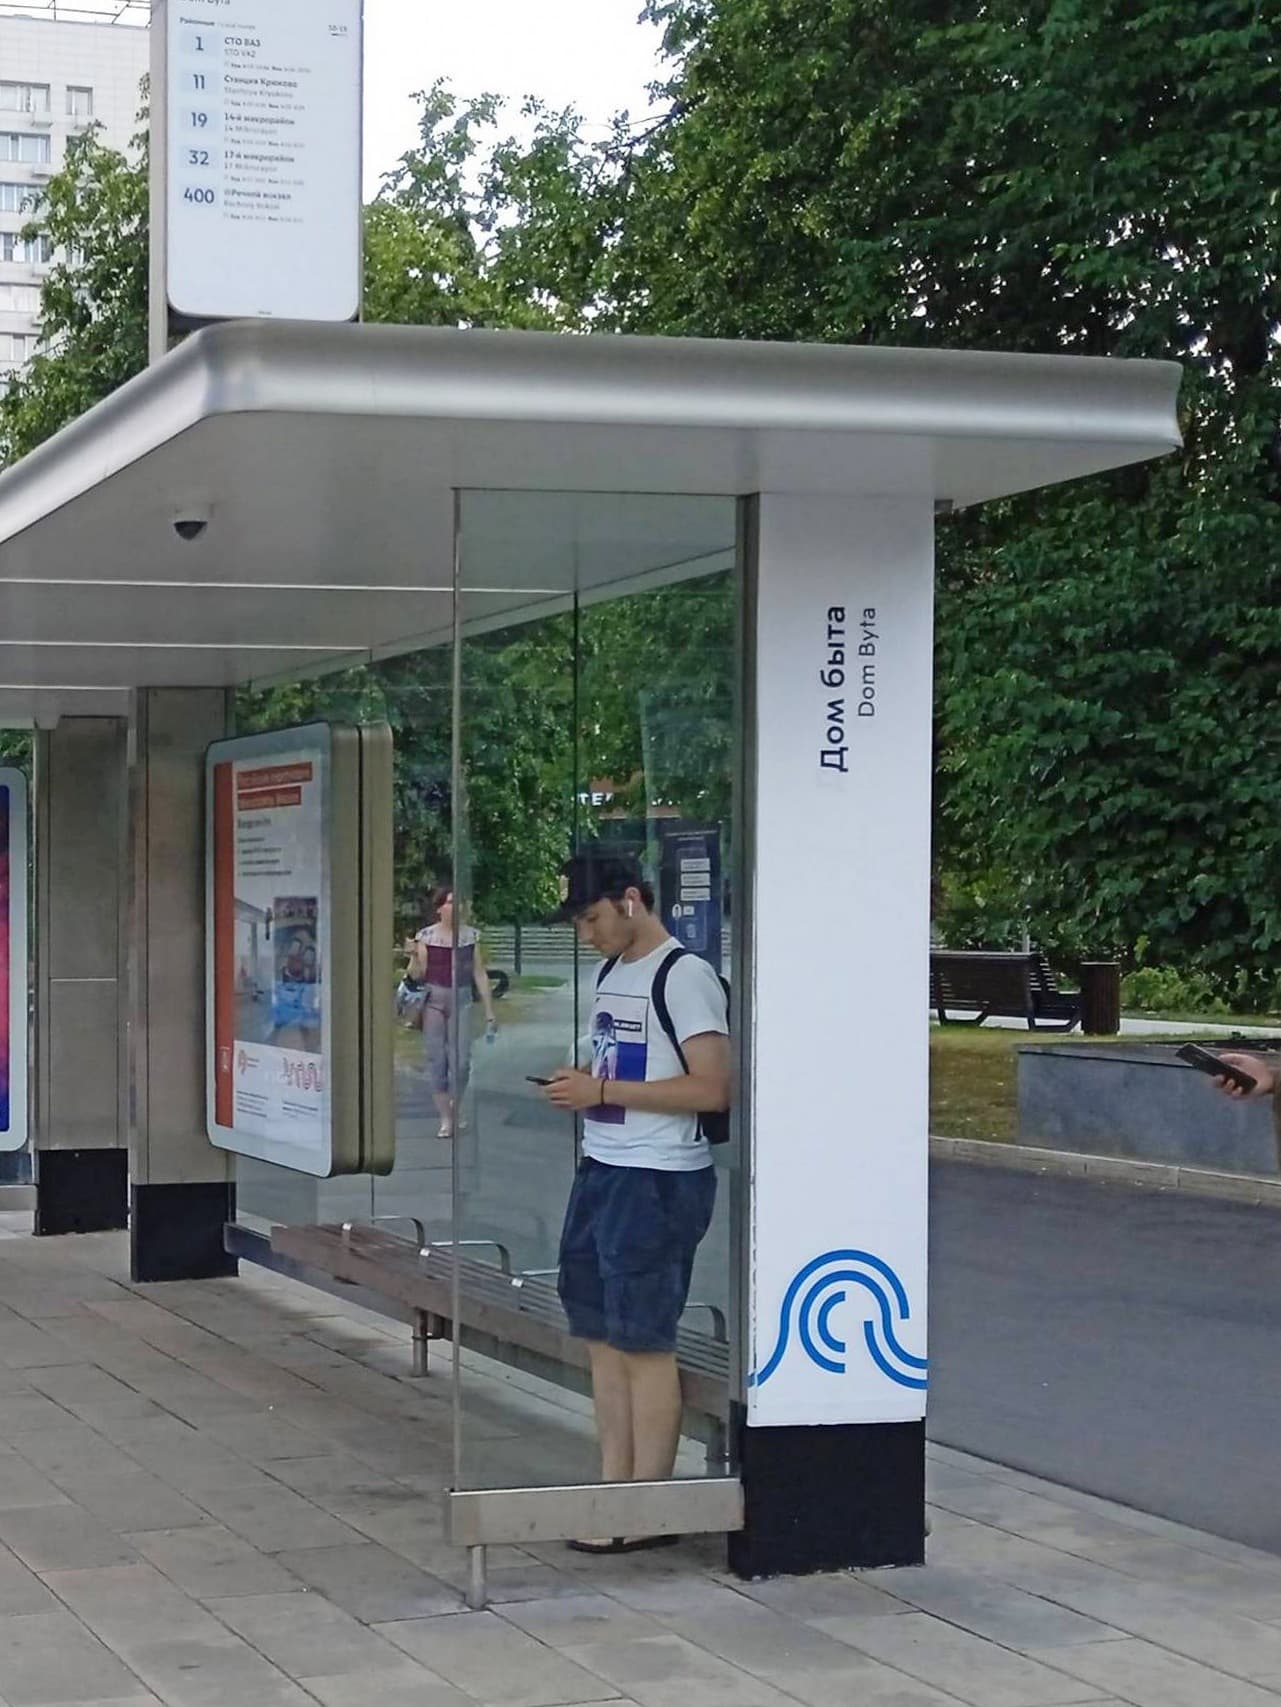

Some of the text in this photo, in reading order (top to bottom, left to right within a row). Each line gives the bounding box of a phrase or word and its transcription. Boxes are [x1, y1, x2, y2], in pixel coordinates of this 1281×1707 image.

[194, 36, 204, 51] 1
[192, 74, 205, 89] 11
[191, 112, 208, 127] 19
[189, 149, 209, 165] 32
[184, 187, 215, 204] 400
[858, 607, 879, 717] Dom Byta
[820, 606, 849, 773] Дом быта
